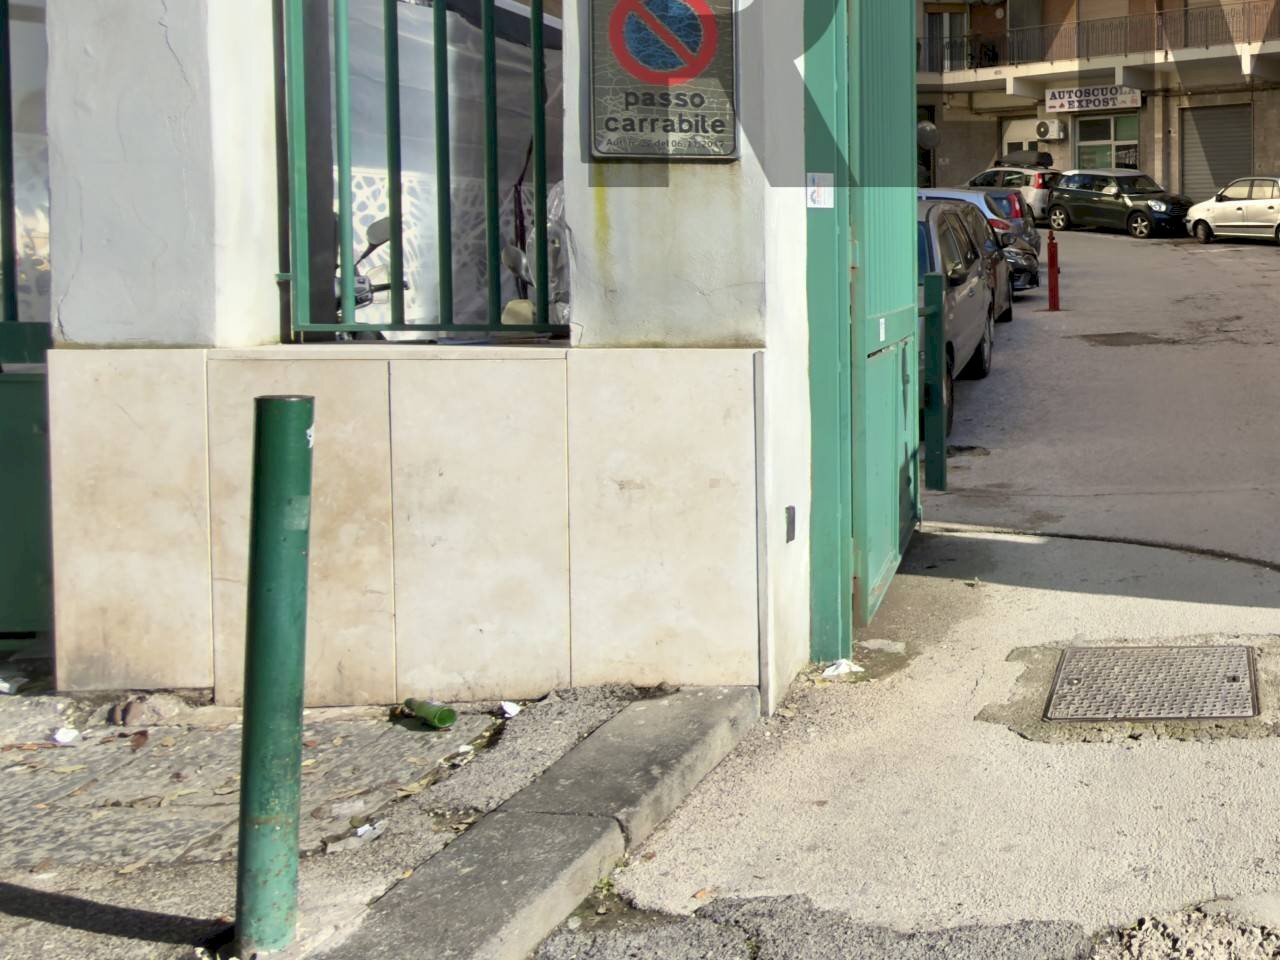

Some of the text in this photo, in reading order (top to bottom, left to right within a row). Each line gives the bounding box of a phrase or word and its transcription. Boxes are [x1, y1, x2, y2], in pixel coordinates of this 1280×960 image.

[624, 91, 706, 111] passo
[1050, 86, 1135, 100] AUTOSCUOLA
[1068, 98, 1118, 109] EXPOST
[604, 113, 726, 134] carrabile
